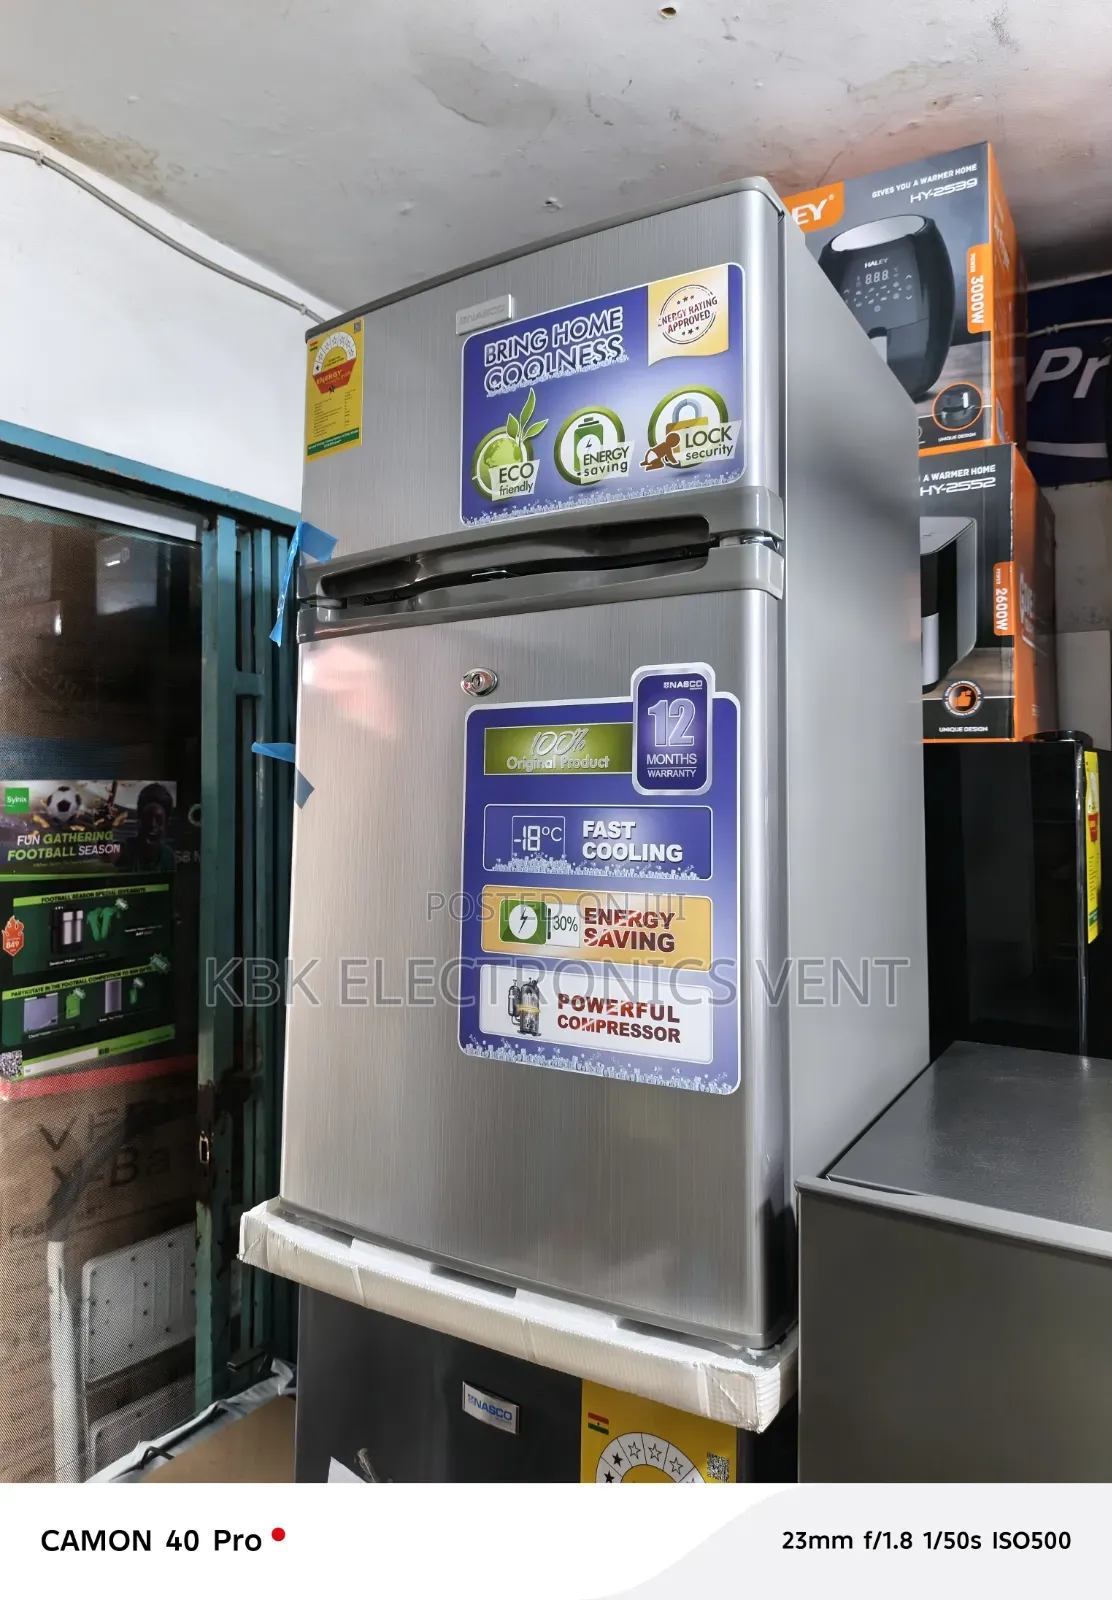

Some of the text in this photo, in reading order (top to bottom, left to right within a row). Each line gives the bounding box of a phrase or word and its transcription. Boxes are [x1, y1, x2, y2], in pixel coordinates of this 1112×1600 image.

[872, 186, 895, 199] GIVES
[896, 182, 911, 192] YOU
[920, 169, 954, 184] WARMER
[954, 163, 977, 176] HOME
[910, 178, 978, 203] HY-2539
[864, 257, 889, 268] HALEY
[970, 275, 985, 324] 3000W
[657, 297, 718, 327] ENERGY RATING
[667, 310, 711, 334] APPROVED
[484, 306, 624, 367] BRING HOME
[484, 336, 625, 394] COOLNESS
[685, 426, 733, 448] LOCK
[583, 446, 630, 466] ENERGY
[685, 444, 734, 460] security
[499, 465, 534, 484] ECO
[584, 461, 628, 477] saving
[923, 464, 996, 482] A WARMER HOME
[499, 480, 535, 495] friendly
[920, 477, 996, 496] HY-2552
[995, 588, 1009, 631] 2600W
[669, 680, 702, 689] NASCO
[648, 698, 696, 747] 12
[531, 728, 589, 757] 100%
[507, 755, 610, 772] Original Product
[646, 753, 697, 765] MONTHS
[647, 769, 697, 778] WARRANTY
[7, 795, 28, 804] Syinix
[17, 831, 114, 847] FUN GATHERING
[582, 820, 636, 840] FAST
[7, 844, 121, 862] FOOTBALL SEASON
[582, 842, 683, 862] COOLING
[552, 915, 579, 933] 30%
[584, 907, 675, 930] ENERGY
[584, 928, 675, 952] SAVING
[557, 993, 680, 1024] POWERFUL
[557, 1014, 681, 1043] COMPRESSOR
[474, 1396, 513, 1421] NASCO
